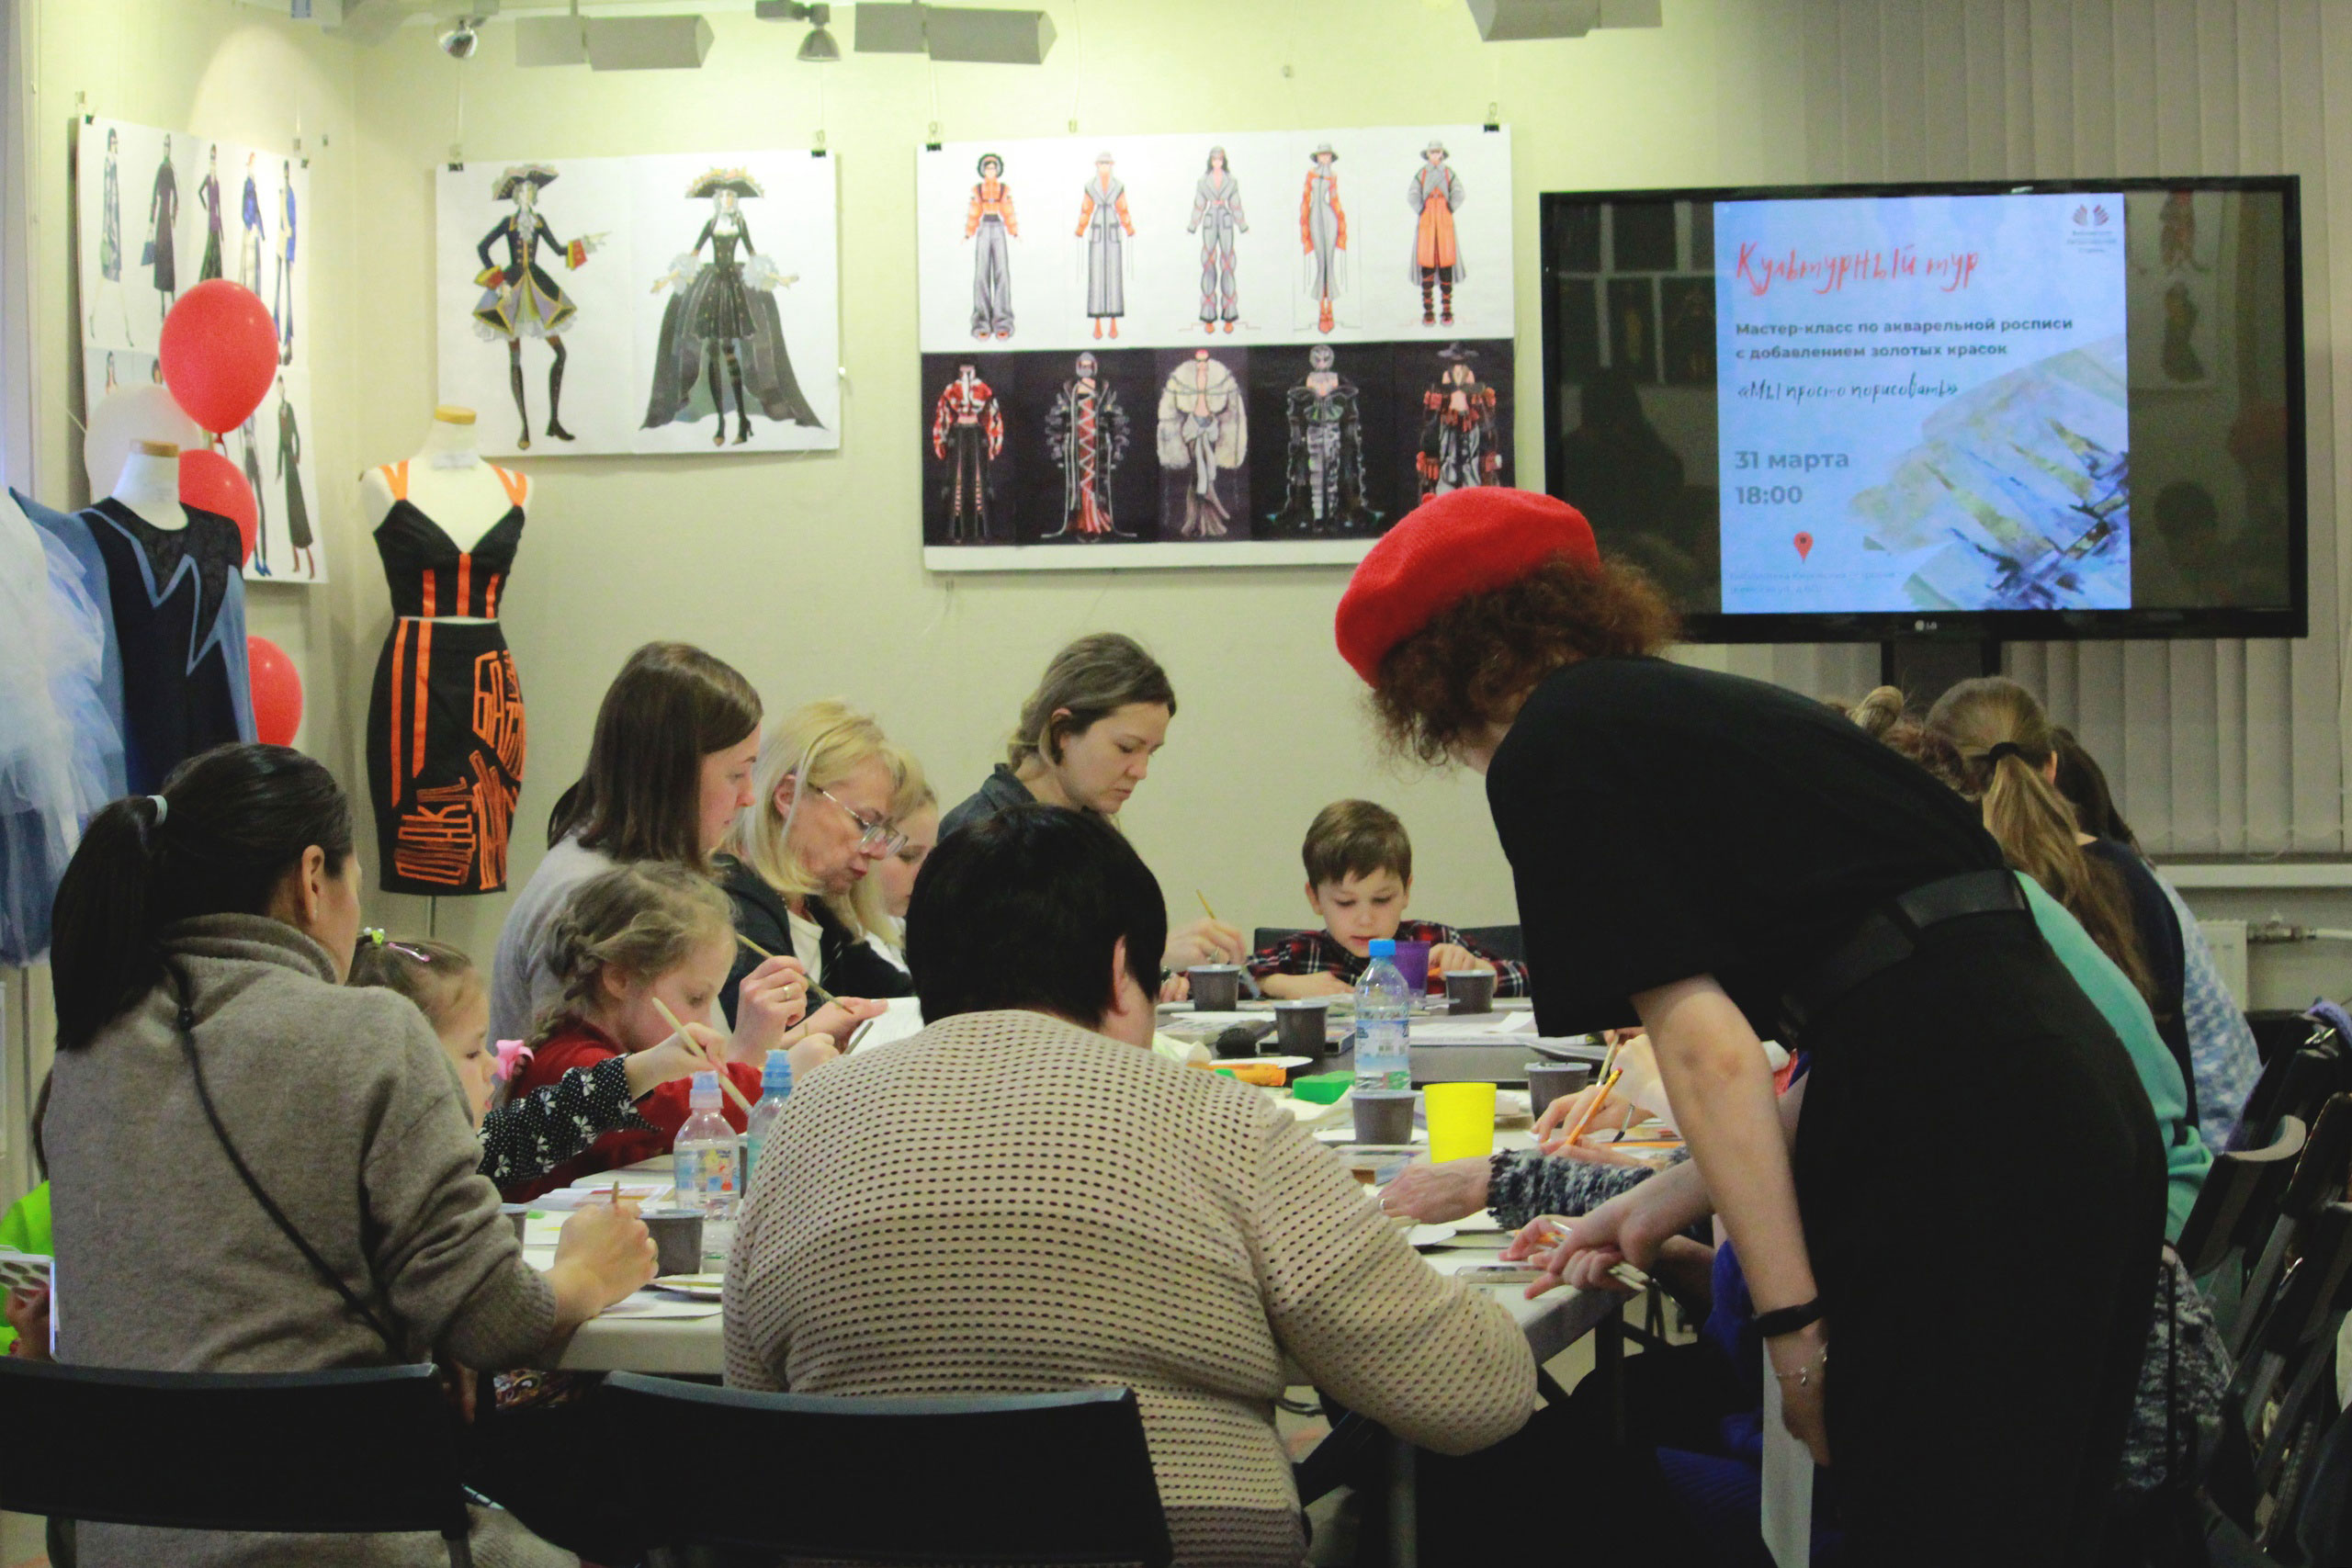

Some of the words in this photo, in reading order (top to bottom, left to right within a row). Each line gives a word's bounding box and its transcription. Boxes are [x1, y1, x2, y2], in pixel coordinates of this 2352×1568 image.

[1736, 243, 1915, 296] Культурный
[1927, 253, 1979, 292] тур
[1736, 322, 1853, 336] Мастер-класс
[1859, 322, 1879, 333] по
[1884, 318, 1996, 334] акварельной
[2001, 318, 2073, 333] росписи
[1736, 349, 1745, 359] с
[1750, 345, 1866, 360] добавлением
[1871, 345, 1942, 357] золотых
[1948, 344, 2007, 358] красок
[1786, 384, 1846, 405] просто
[1735, 450, 1759, 470] 31
[1768, 450, 1850, 473] марта
[1735, 485, 1804, 505] 18:00
